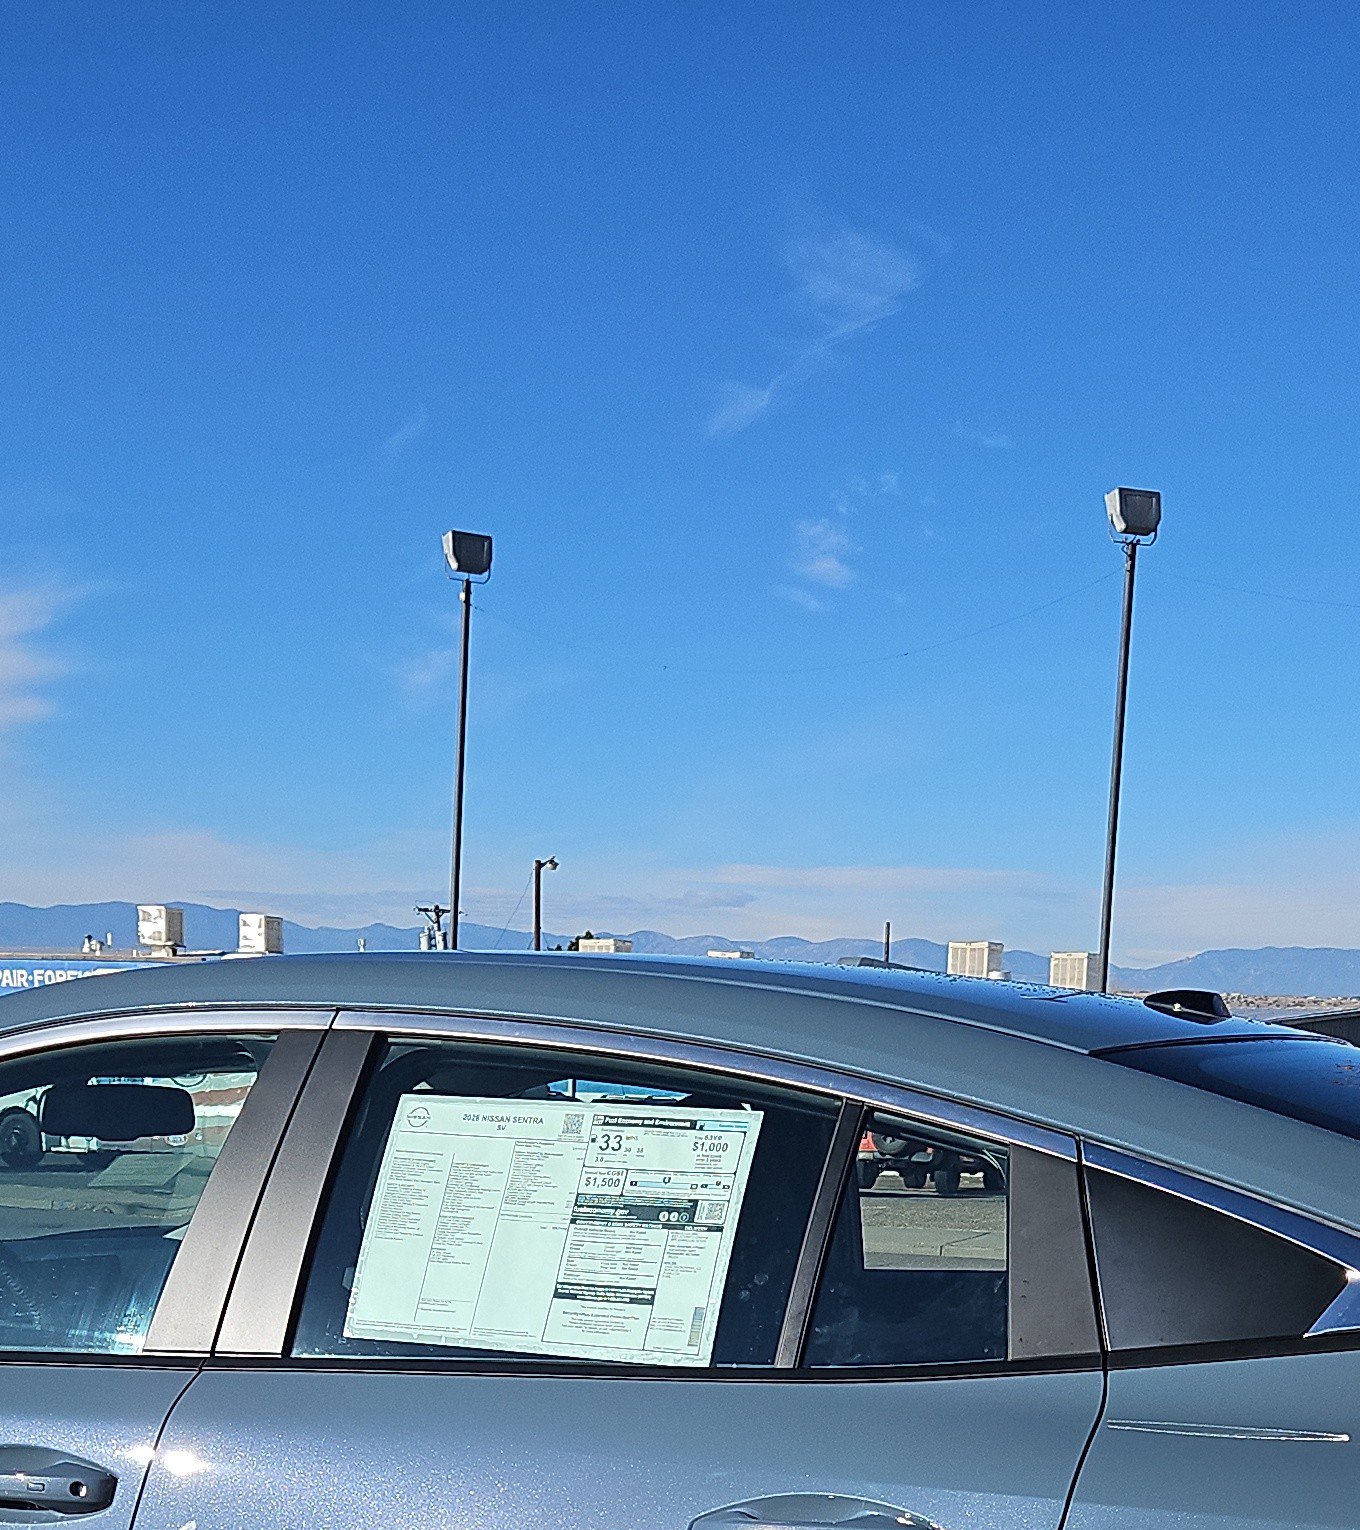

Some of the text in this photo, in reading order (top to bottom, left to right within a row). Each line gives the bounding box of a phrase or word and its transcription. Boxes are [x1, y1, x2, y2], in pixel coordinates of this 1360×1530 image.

[481, 1114, 511, 1123] NISSAN
[512, 1116, 544, 1125] SENTRA
[598, 1133, 623, 1152] 33
[692, 1141, 728, 1153] $1,000
[584, 1176, 621, 1189] $1,500
